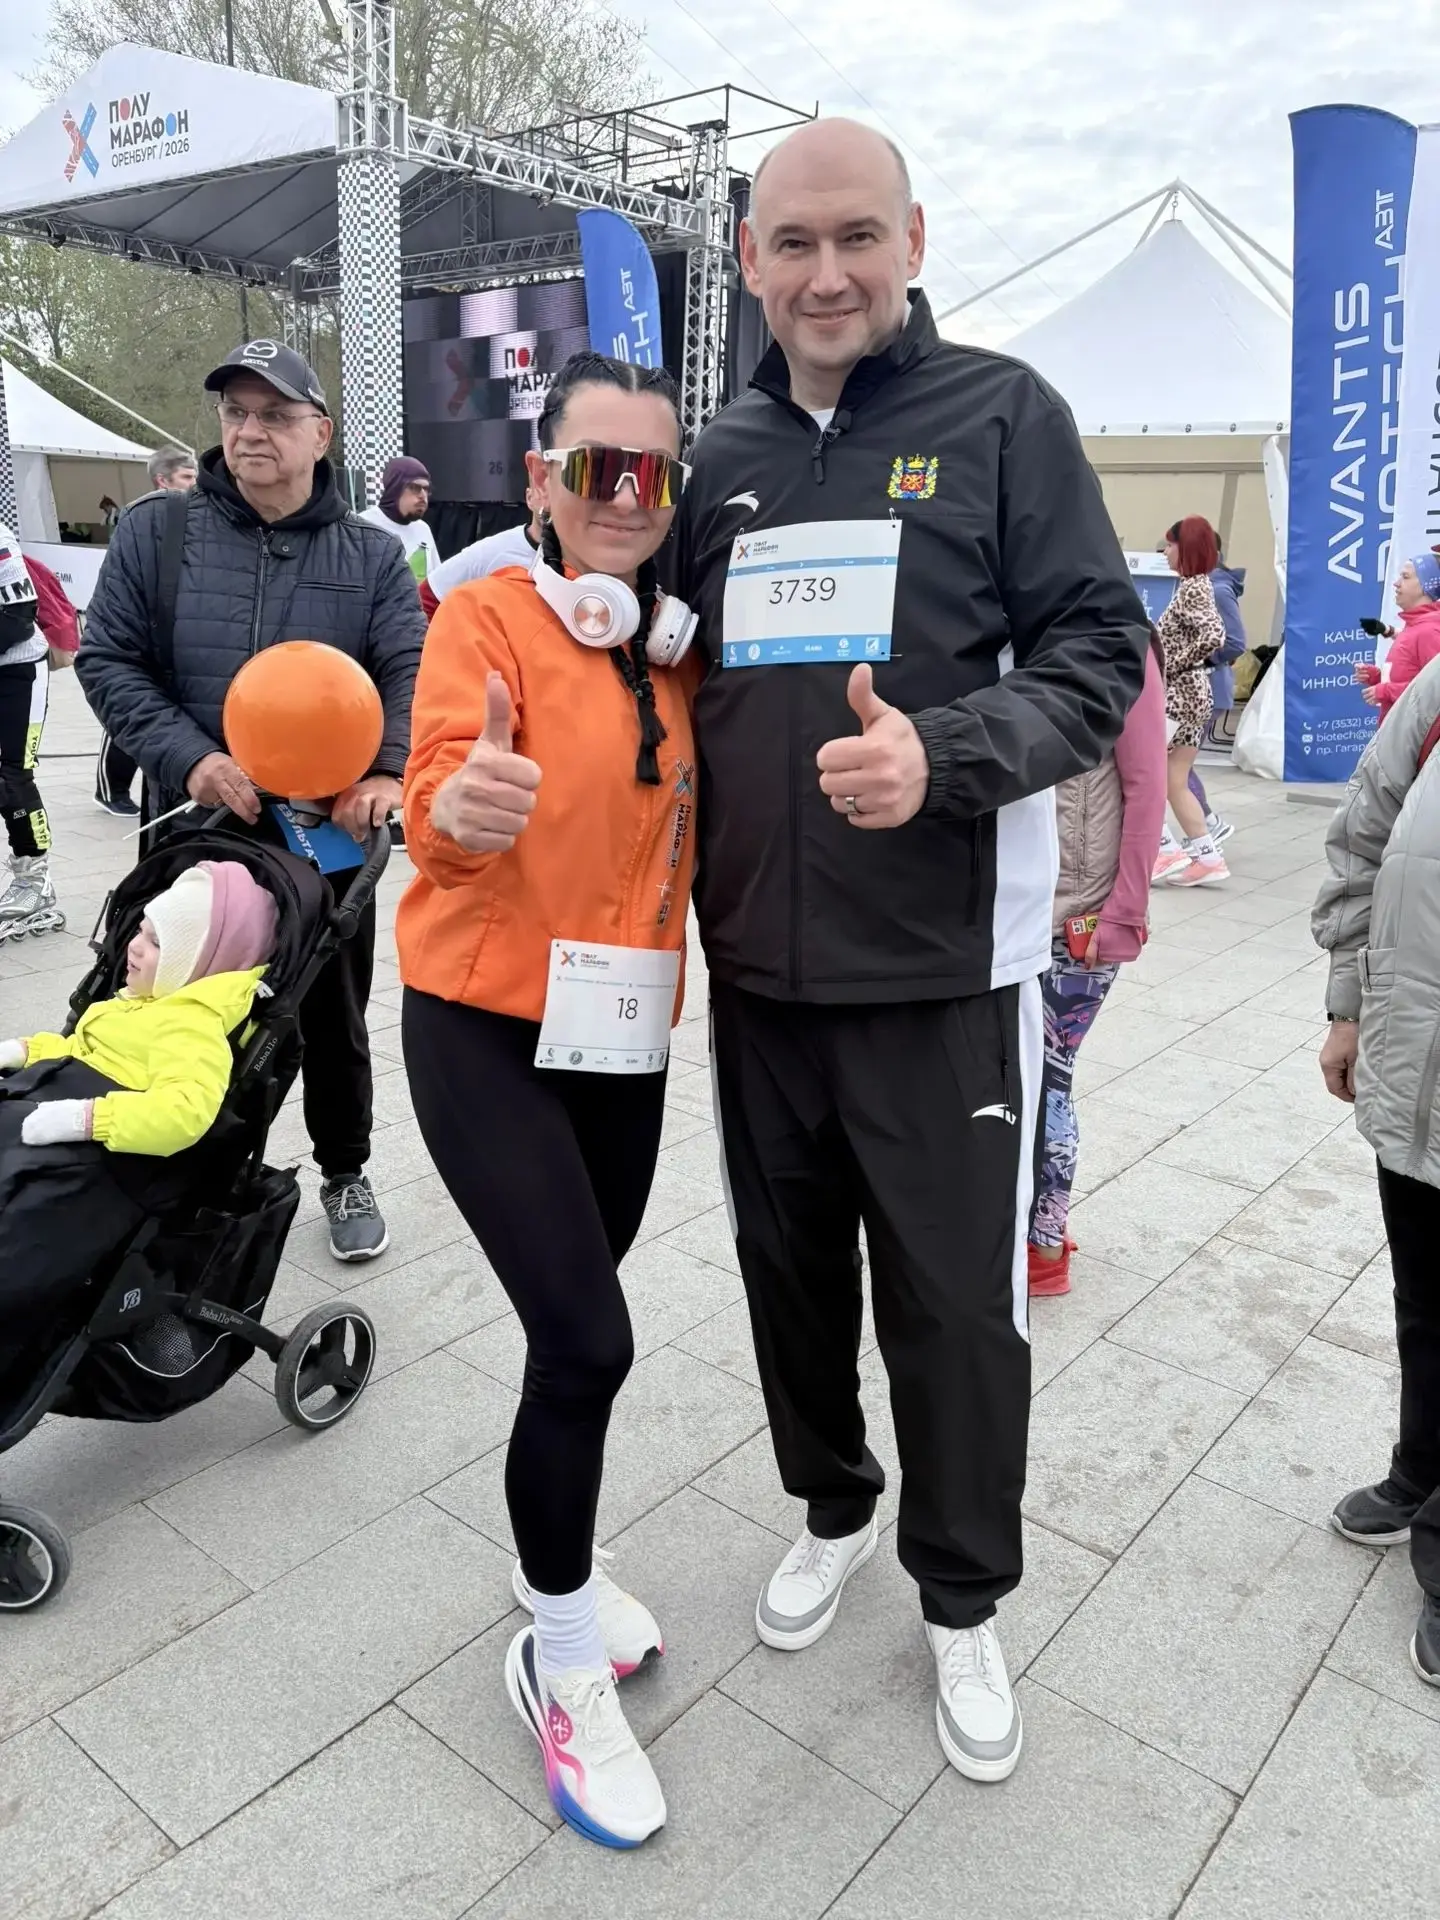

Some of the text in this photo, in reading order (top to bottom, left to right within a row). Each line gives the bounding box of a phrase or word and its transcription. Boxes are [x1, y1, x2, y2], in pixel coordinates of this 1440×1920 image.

[109, 92, 151, 124] ПОЛУ
[110, 109, 189, 149] МАРАФОН
[1328, 282, 1370, 584] AVANTIS
[489, 461, 503, 474] 26
[769, 577, 836, 605] 3739
[1331, 717, 1361, 731] (3532)
[1335, 743, 1368, 753] Гагар
[617, 997, 639, 1020] 18
